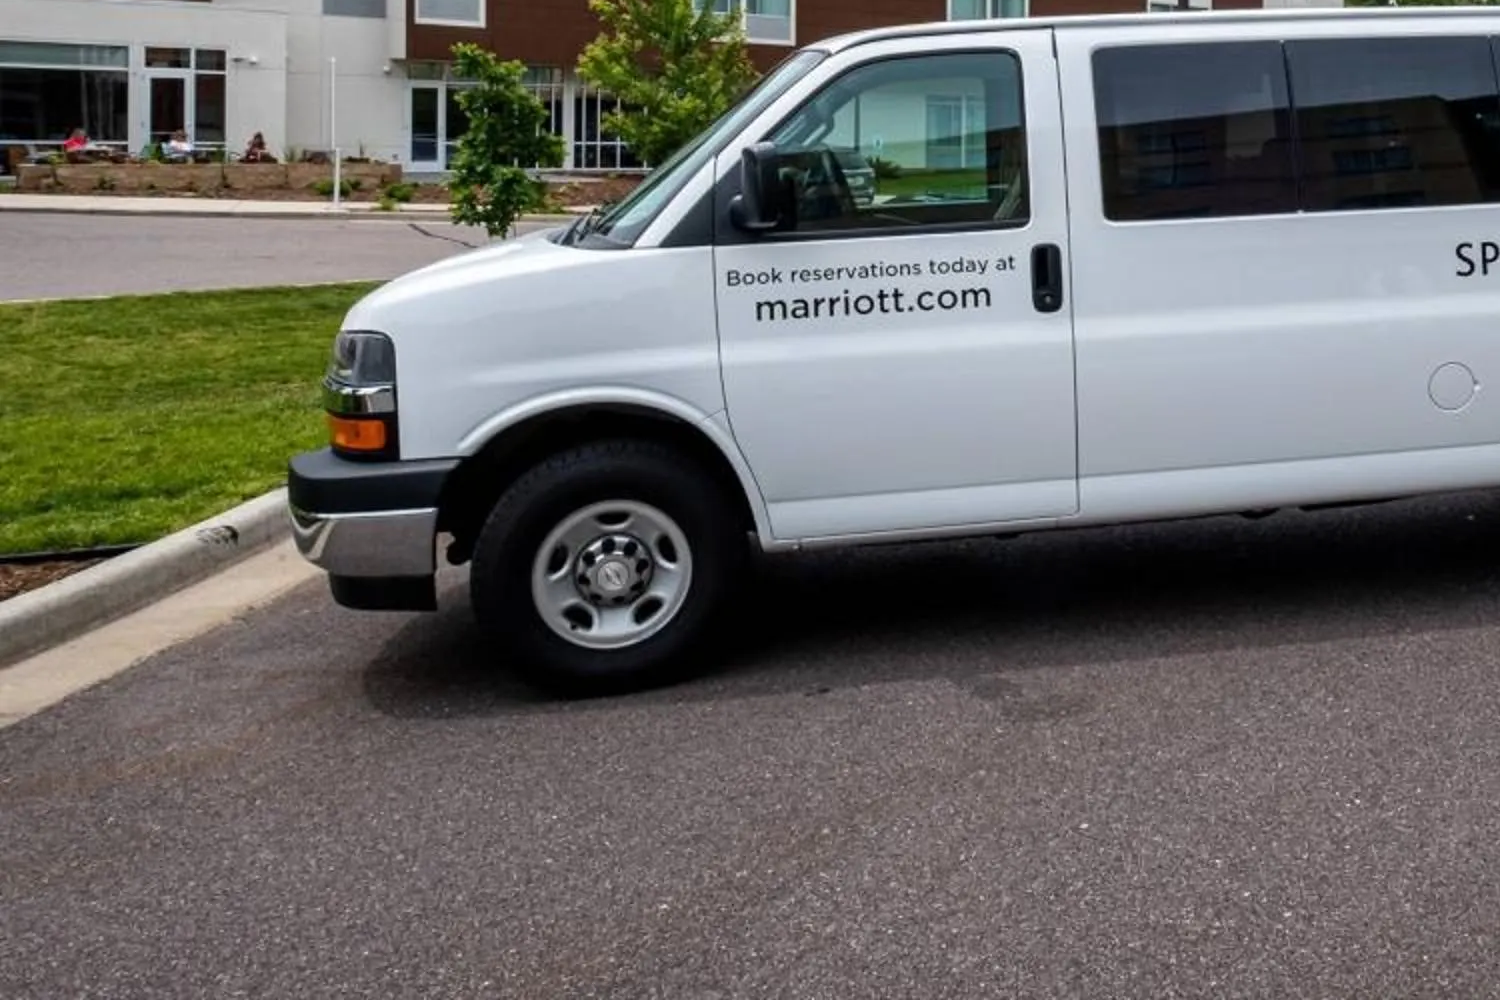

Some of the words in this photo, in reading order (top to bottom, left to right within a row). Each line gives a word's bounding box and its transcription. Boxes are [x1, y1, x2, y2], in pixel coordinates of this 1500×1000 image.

[727, 267, 783, 287] Book
[790, 260, 922, 282] reservations
[929, 256, 989, 276] today
[995, 254, 1017, 271] at
[755, 286, 993, 321] marriott.com
